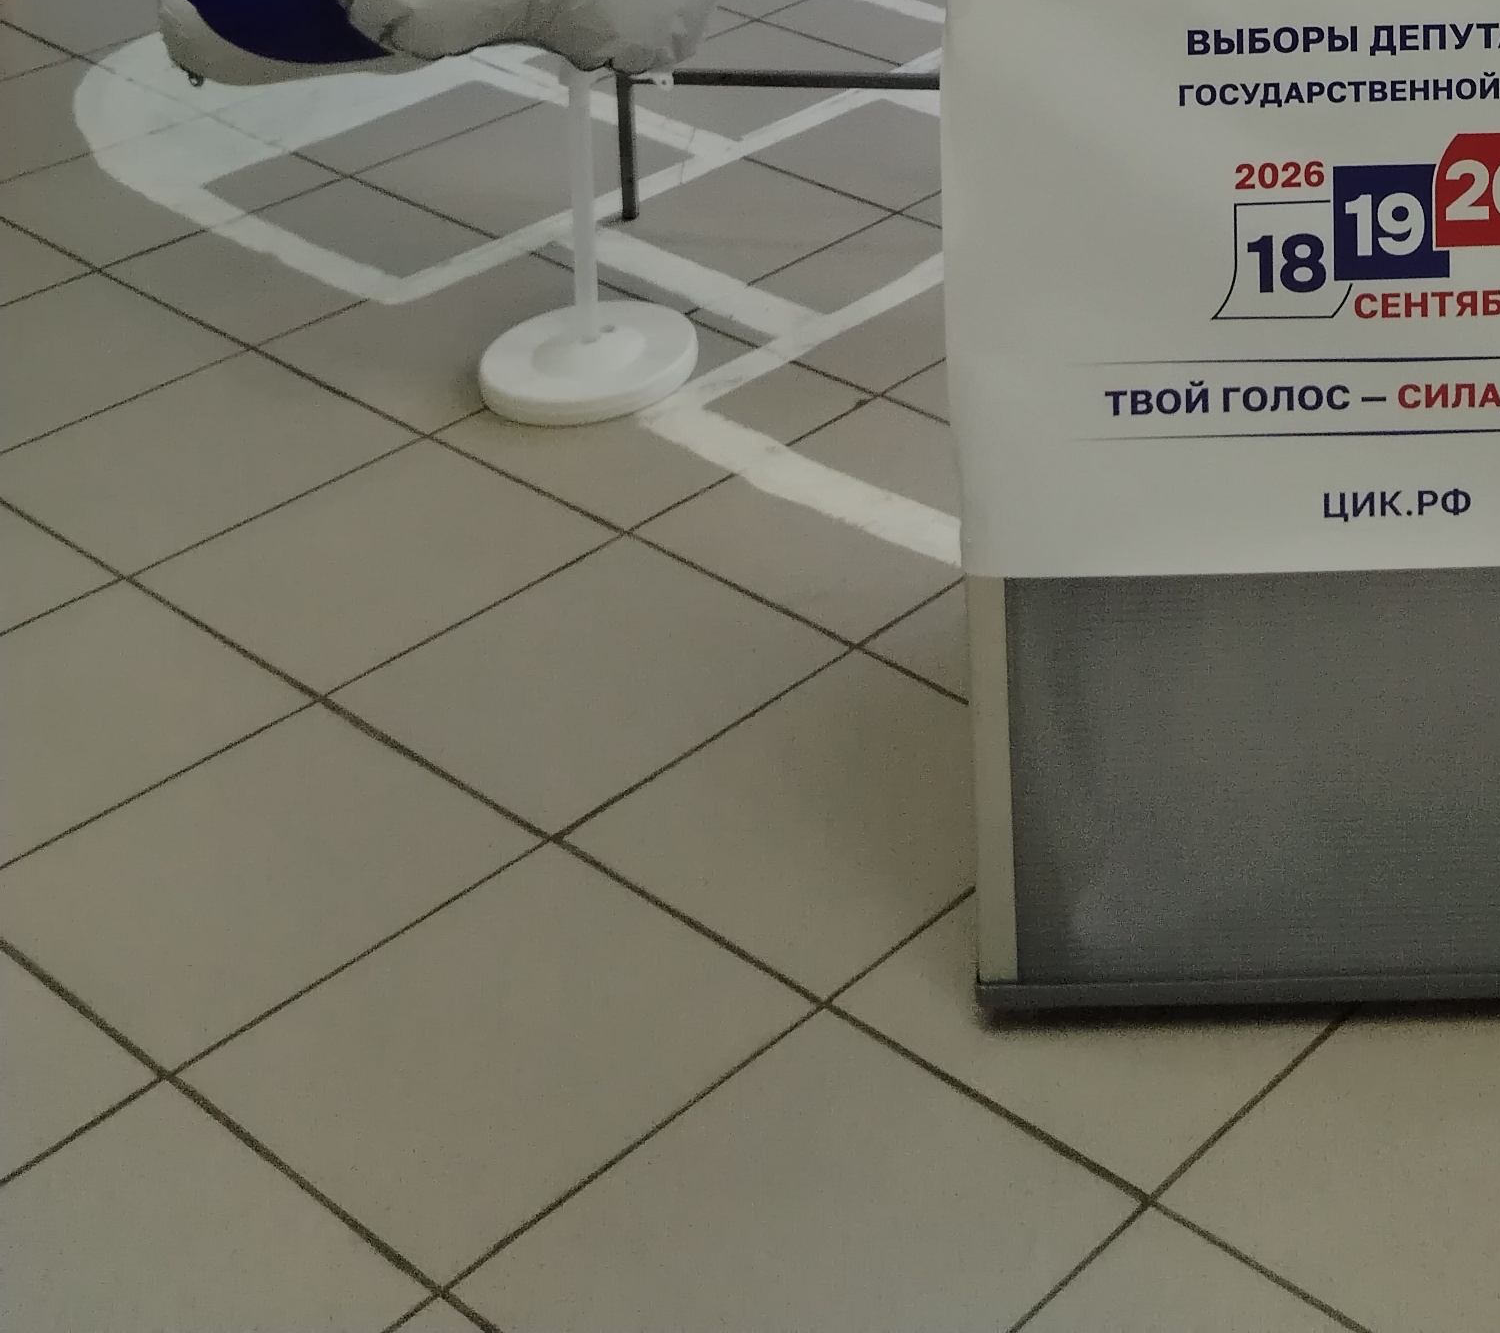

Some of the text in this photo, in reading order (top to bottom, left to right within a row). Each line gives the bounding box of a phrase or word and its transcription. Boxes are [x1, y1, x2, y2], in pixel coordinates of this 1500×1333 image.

[1187, 26, 1358, 55] ВЫБОРЫ
[1178, 72, 1499, 108] ГОСУДАРСТВЕННОЙ
[1234, 161, 1325, 190] 2026
[1247, 233, 1327, 293] 18
[1345, 192, 1425, 257] 19
[1105, 381, 1210, 416] ТВОЙ
[1223, 384, 1351, 413] ГОЛОС
[1323, 488, 1471, 522] ЦИК.РФ
